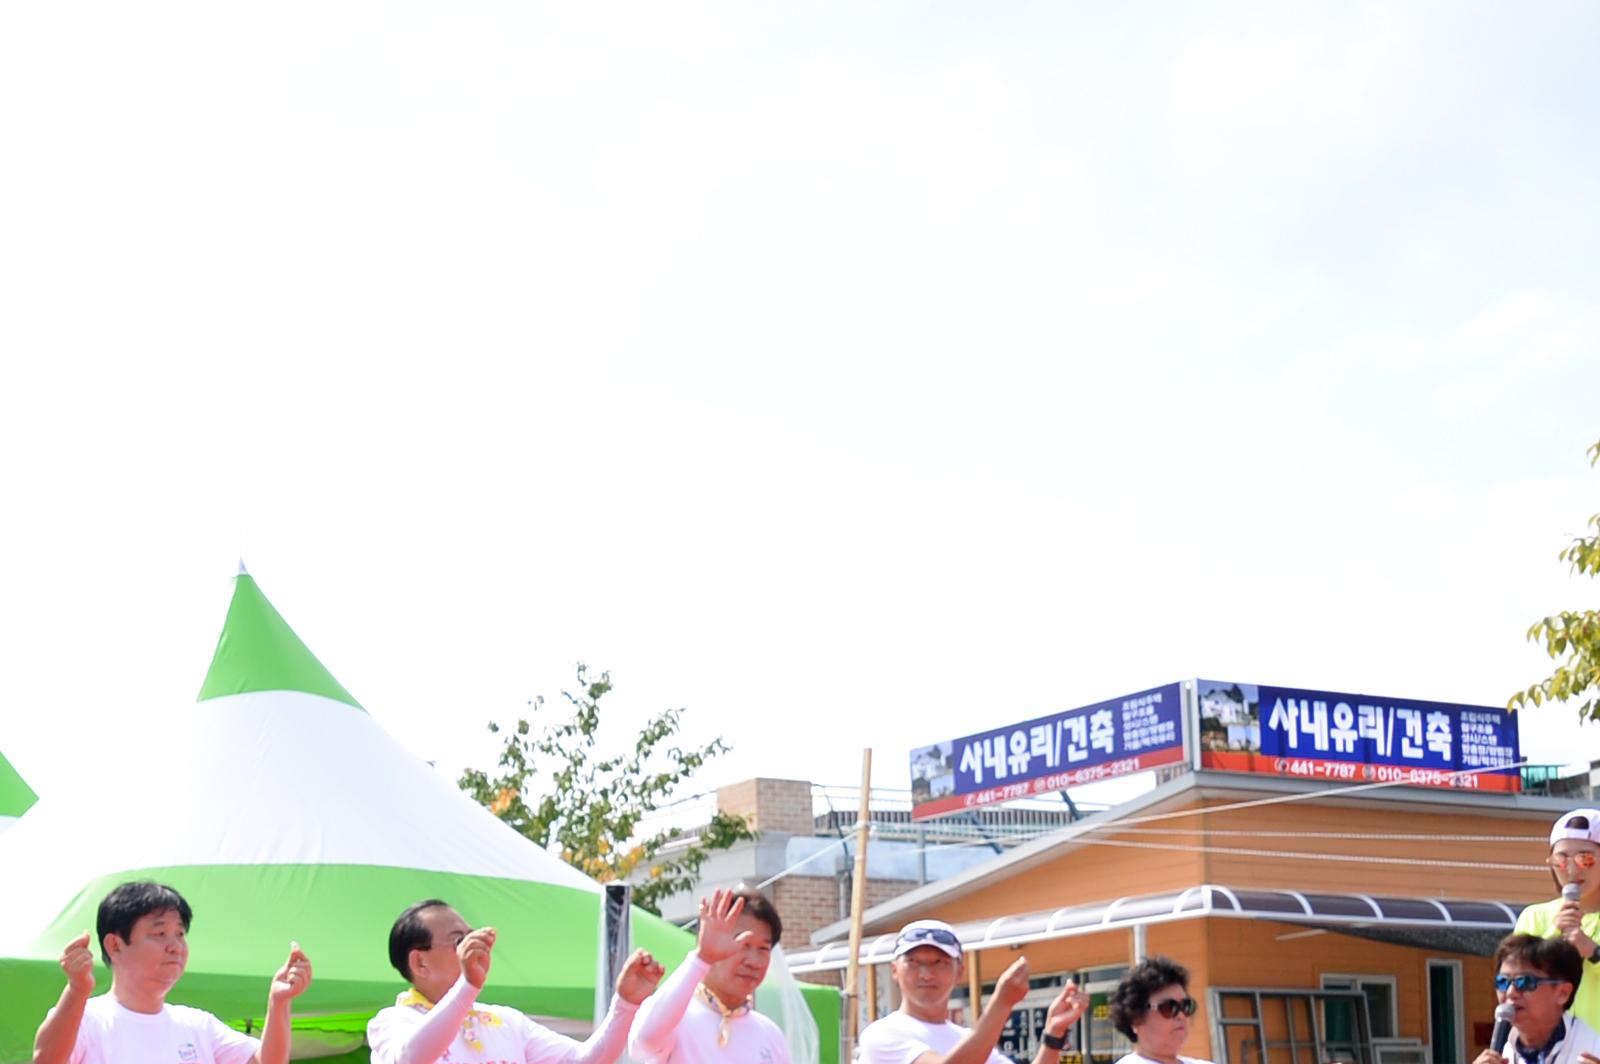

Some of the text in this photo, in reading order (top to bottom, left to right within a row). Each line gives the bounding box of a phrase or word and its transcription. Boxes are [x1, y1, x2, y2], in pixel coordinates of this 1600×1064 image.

[959, 708, 1115, 784] 사내유리/건축
[1267, 697, 1452, 761] 사내유리/건축
[1046, 758, 1140, 789] 010-6375-2321
[1290, 761, 1478, 787] 441-7787 010-6375-2321
